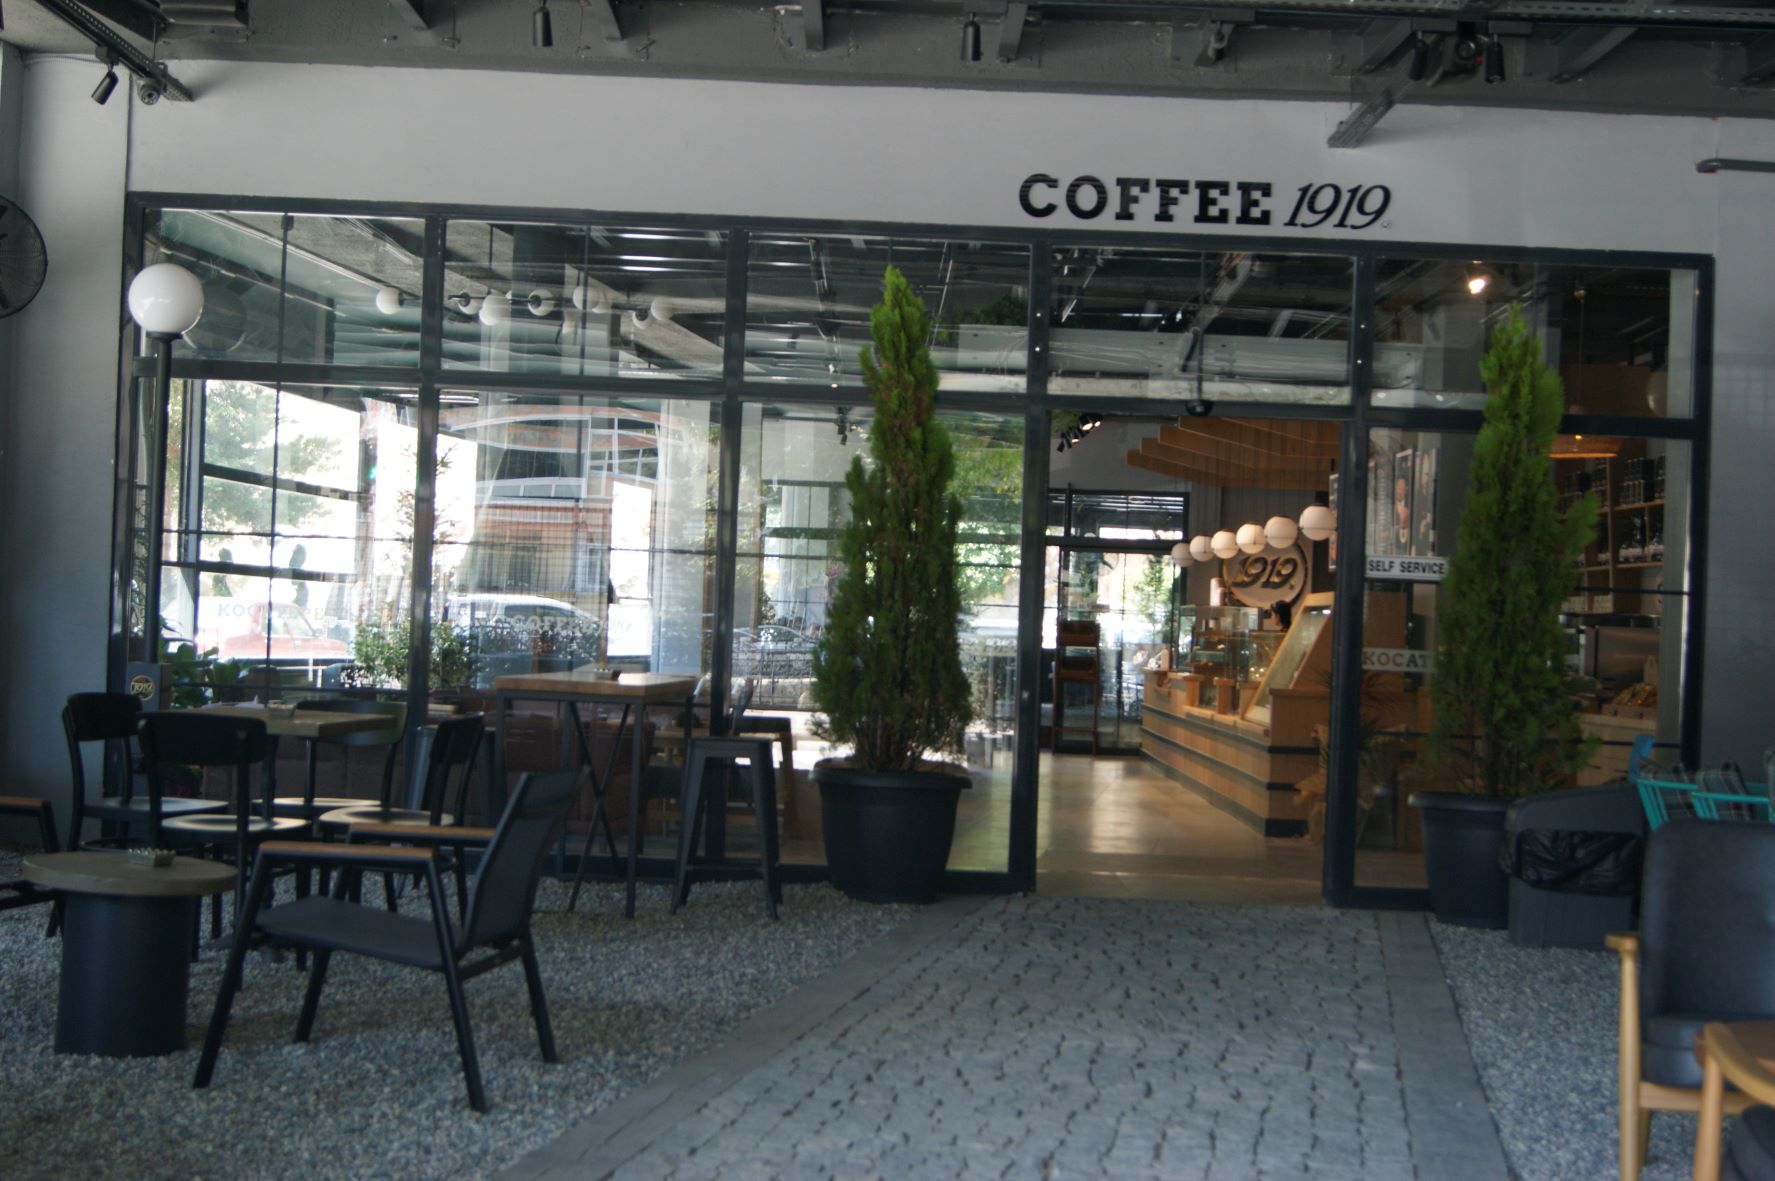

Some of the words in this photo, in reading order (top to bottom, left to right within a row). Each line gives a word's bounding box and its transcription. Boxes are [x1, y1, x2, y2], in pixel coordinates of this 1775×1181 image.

[1018, 173, 1272, 225] COFFEE
[1283, 182, 1392, 230] 1919
[1232, 556, 1298, 590] 1919
[1368, 560, 1394, 572] SELF
[1399, 561, 1446, 575] SERVICE
